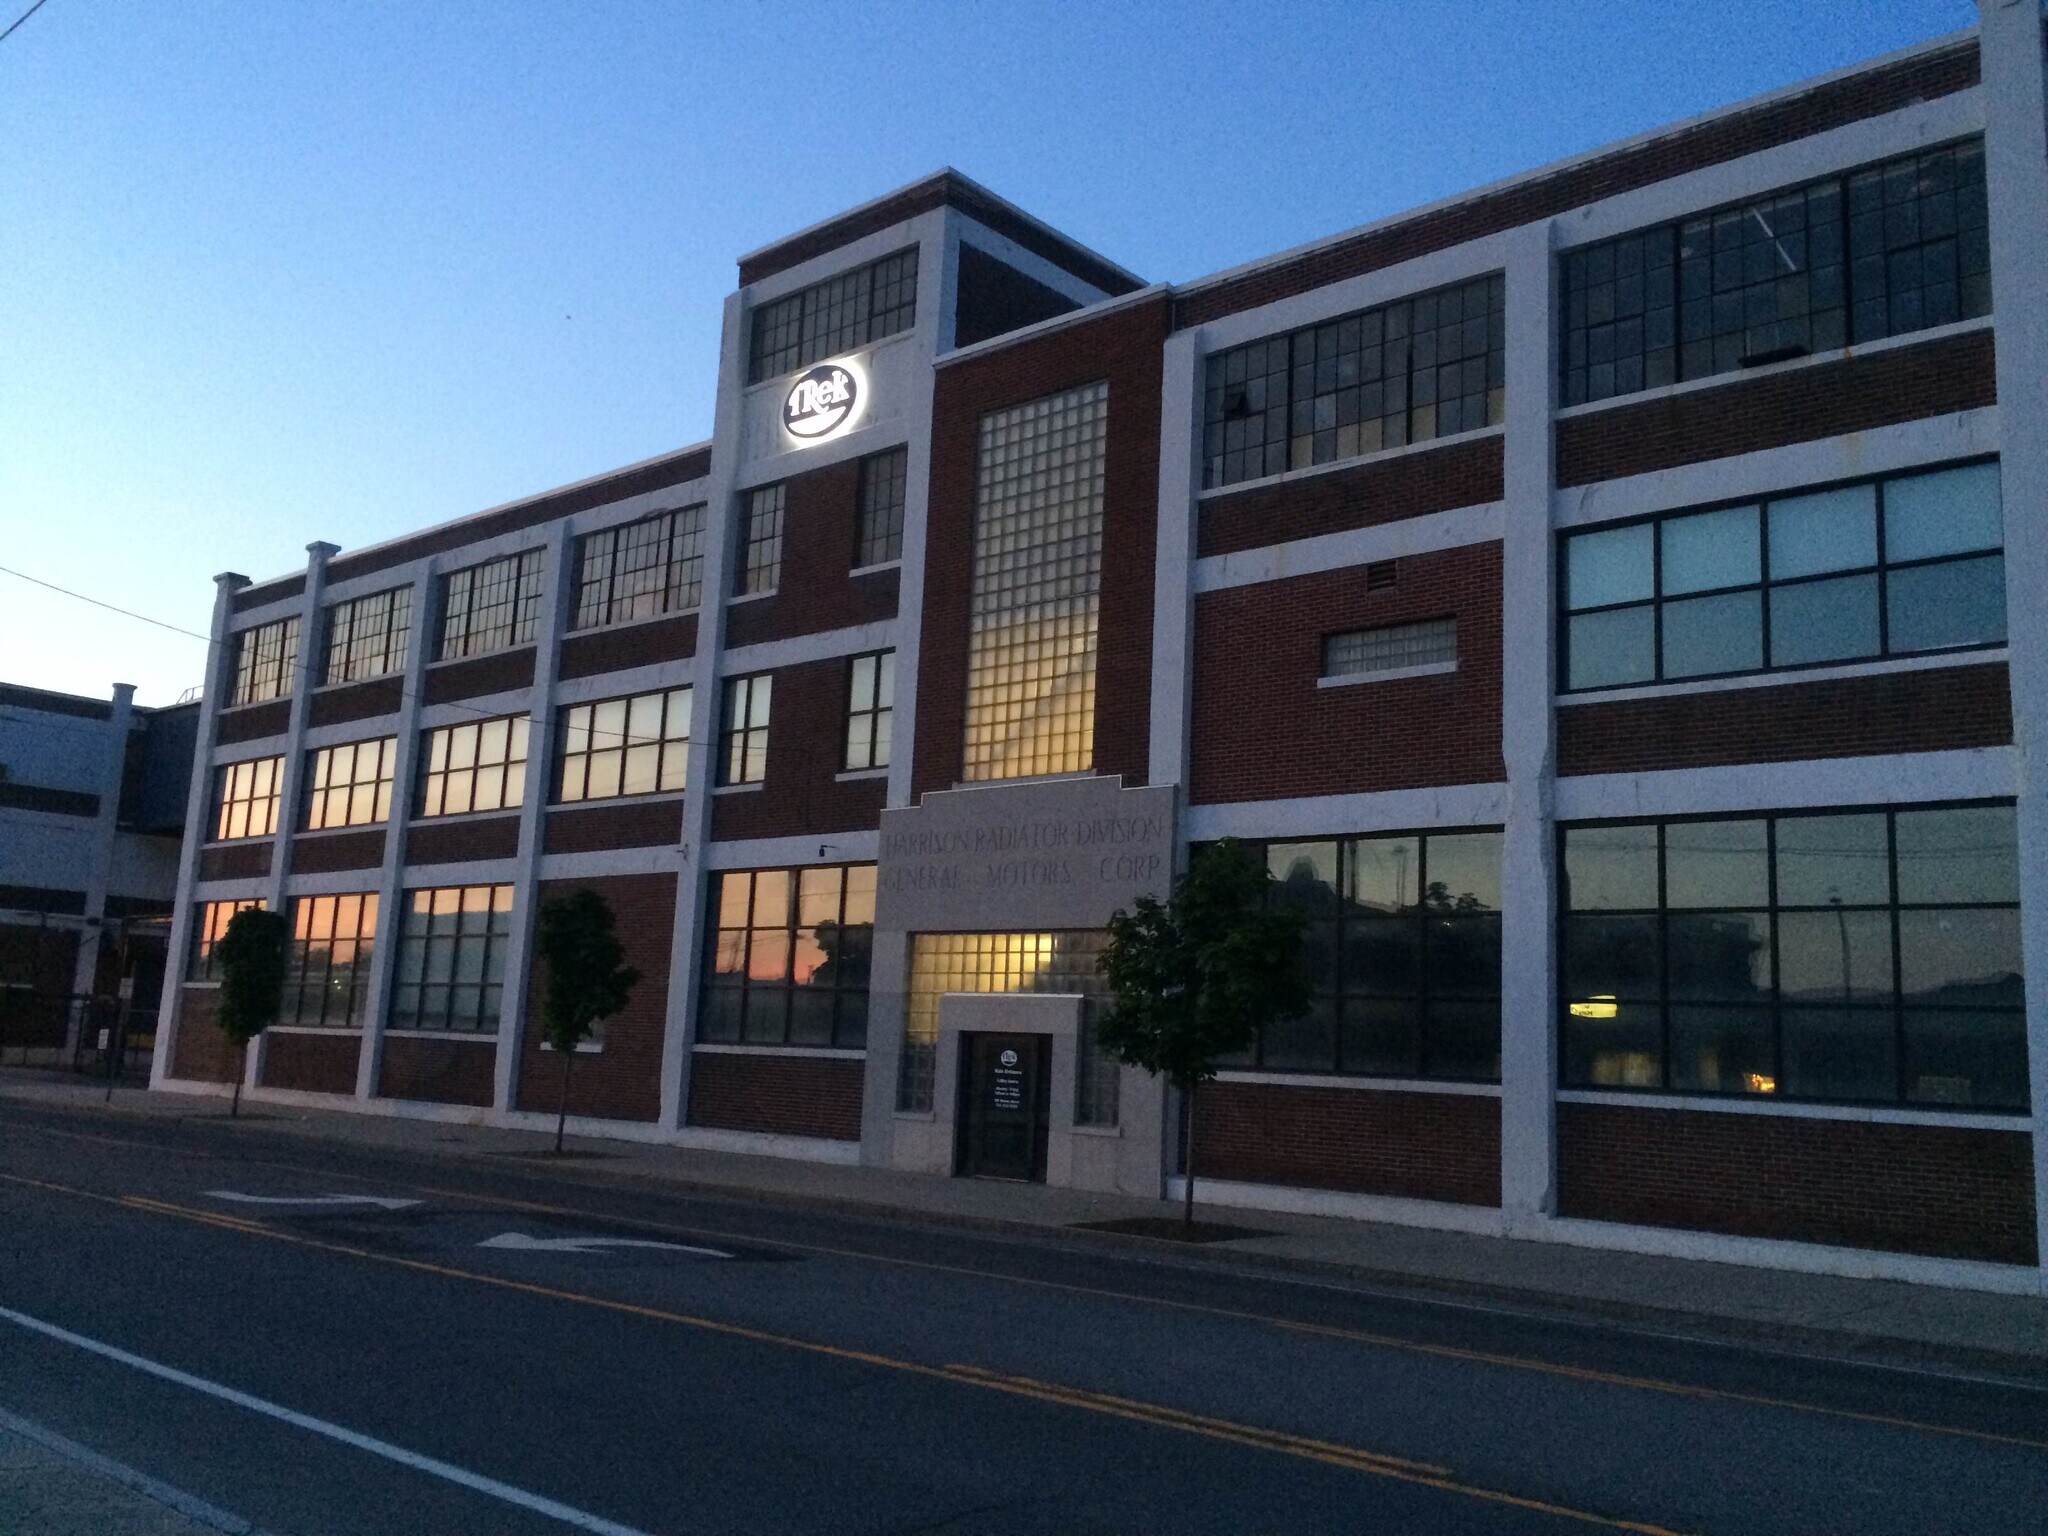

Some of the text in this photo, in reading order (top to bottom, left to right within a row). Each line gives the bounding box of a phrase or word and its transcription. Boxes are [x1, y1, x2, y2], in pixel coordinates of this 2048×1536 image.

[885, 815, 1162, 859] HARRISON RADIATOR DIVISION
[883, 853, 1161, 891] GENERAL MOTORS CORP
